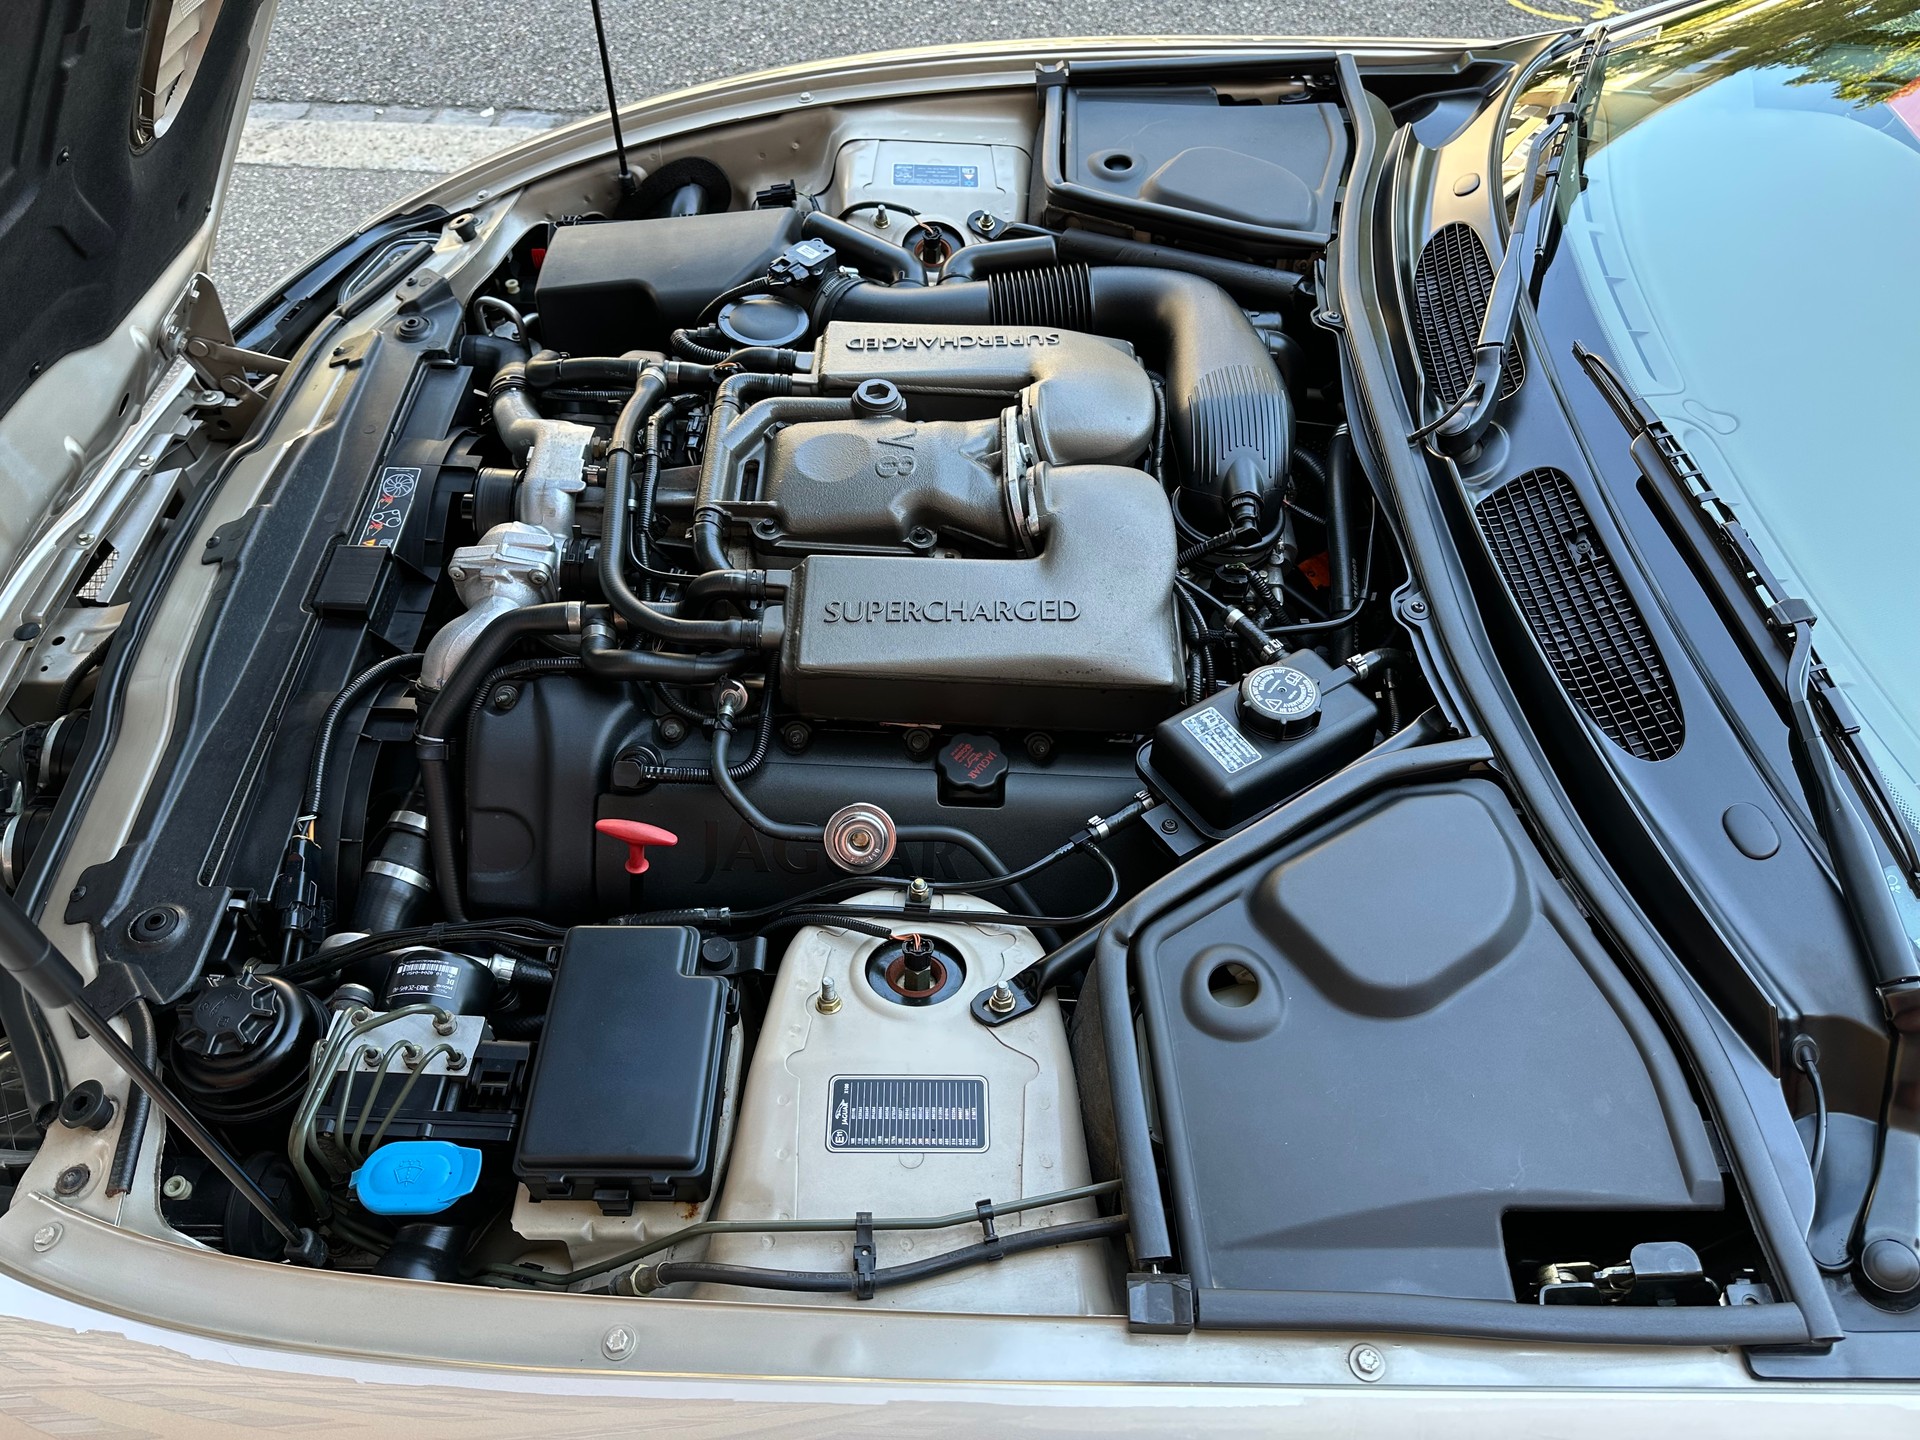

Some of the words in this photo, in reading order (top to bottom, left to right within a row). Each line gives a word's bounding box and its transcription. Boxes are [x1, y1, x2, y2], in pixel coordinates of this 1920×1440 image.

[845, 333, 1060, 353] SUPERCHARGED
[875, 428, 917, 479] V8
[823, 599, 1081, 624] SUPERCHARGED
[967, 749, 997, 779] JAGUAR
[841, 1102, 849, 1126] JAGUAR
[789, 1271, 810, 1280] DOT
[815, 1272, 823, 1280] C
